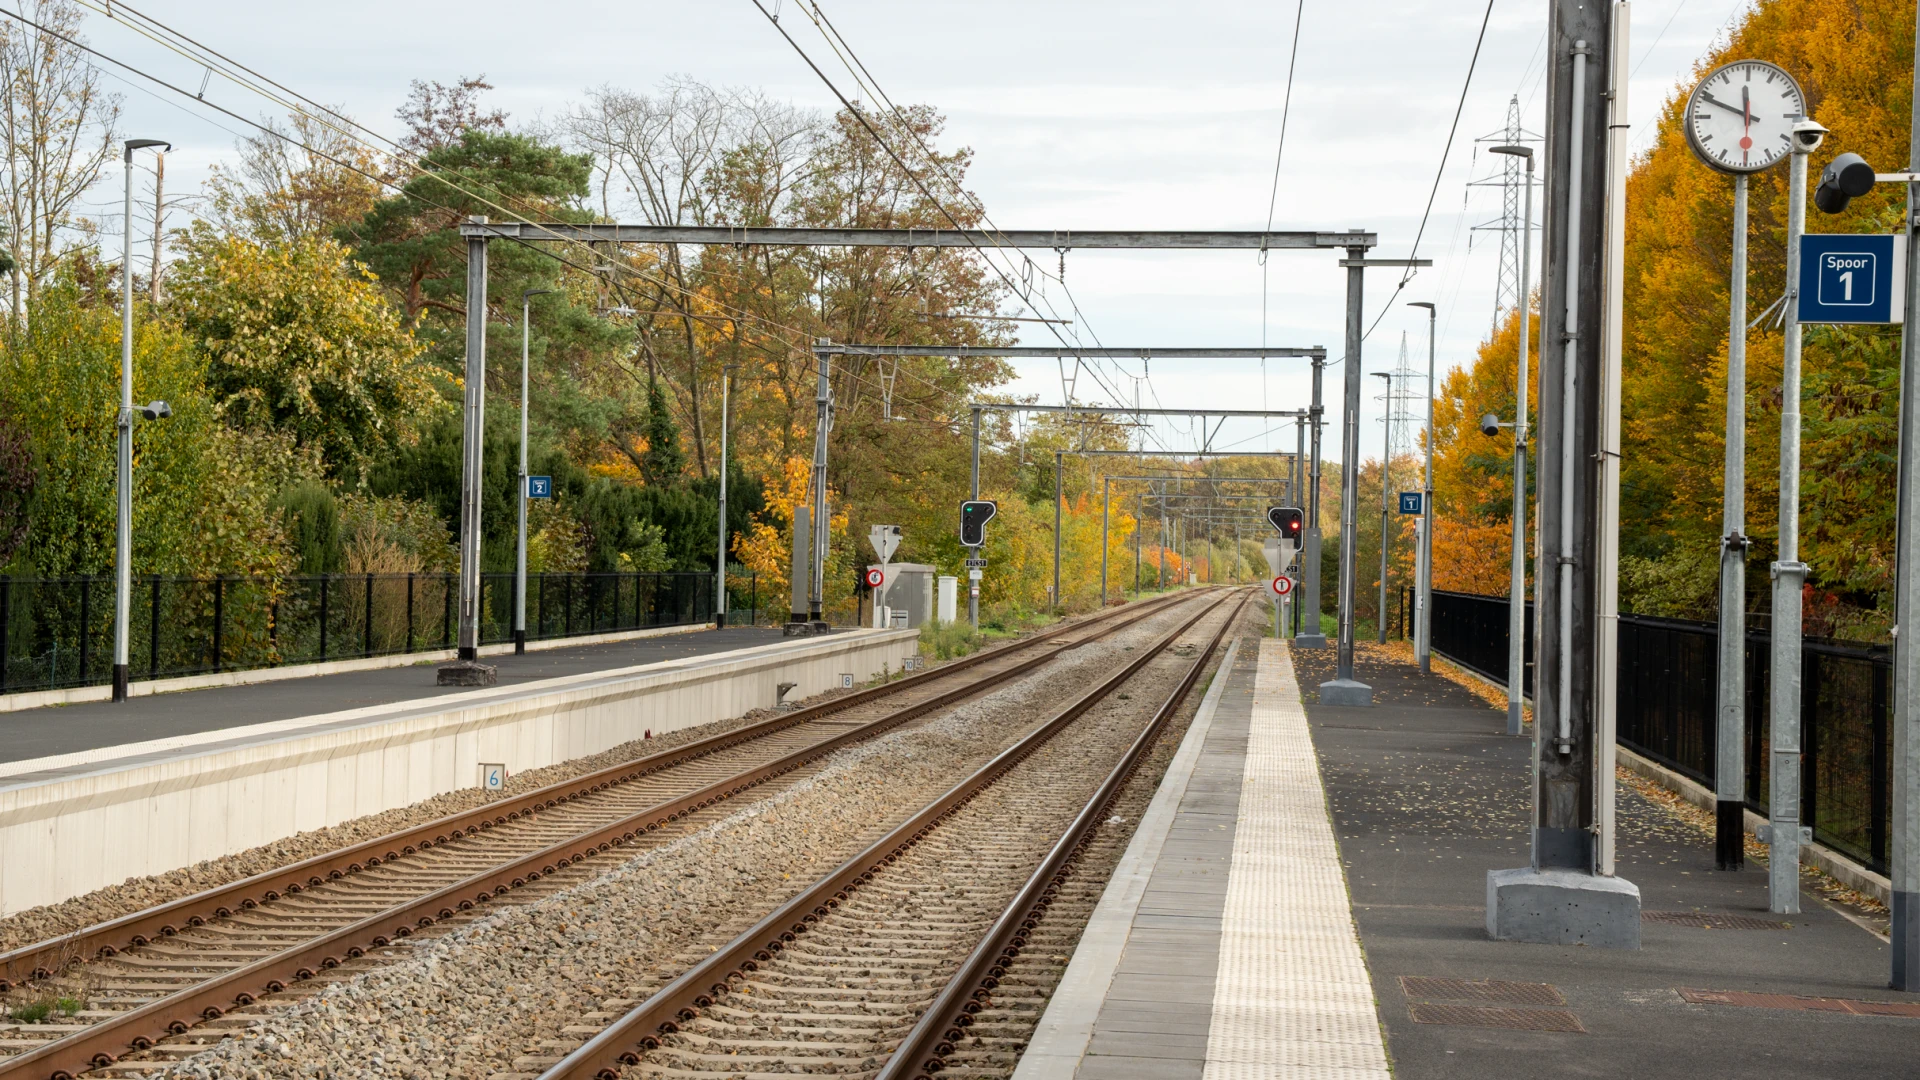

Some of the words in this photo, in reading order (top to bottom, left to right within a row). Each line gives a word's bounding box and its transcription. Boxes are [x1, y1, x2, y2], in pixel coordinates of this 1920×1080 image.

[1827, 256, 1868, 271] Spoor
[1839, 271, 1853, 301] 1
[537, 484, 543, 493] 2
[1408, 500, 1413, 509] 1
[906, 661, 913, 669] 10
[916, 658, 923, 666] 12
[844, 676, 851, 686] 8
[489, 769, 499, 786] 6
